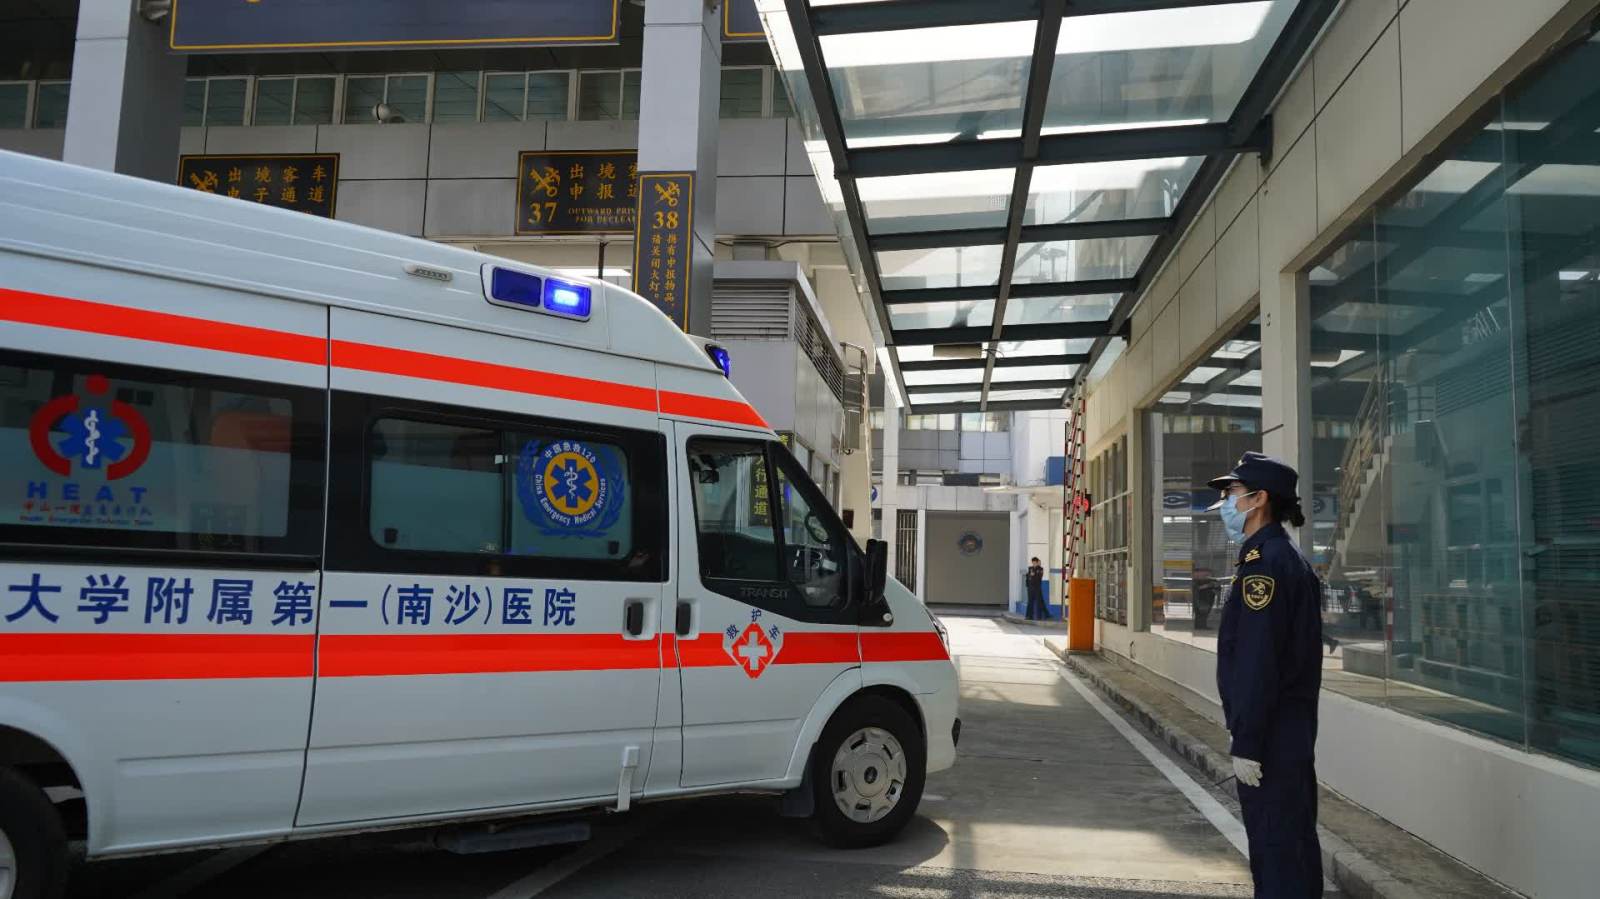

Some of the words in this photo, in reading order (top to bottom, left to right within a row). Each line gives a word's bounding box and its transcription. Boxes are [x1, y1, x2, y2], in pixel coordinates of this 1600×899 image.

[228, 164, 327, 183] 出境客车
[227, 186, 325, 203] 电子通道
[527, 200, 558, 225] 37
[568, 207, 612, 216] OUTWARD
[575, 215, 593, 223] FOR
[652, 210, 679, 230] 38
[27, 480, 148, 504] HEAT
[540, 496, 571, 526] Emergency
[574, 509, 597, 525] Medical
[595, 478, 606, 508] Services
[726, 608, 781, 641] 救护车
